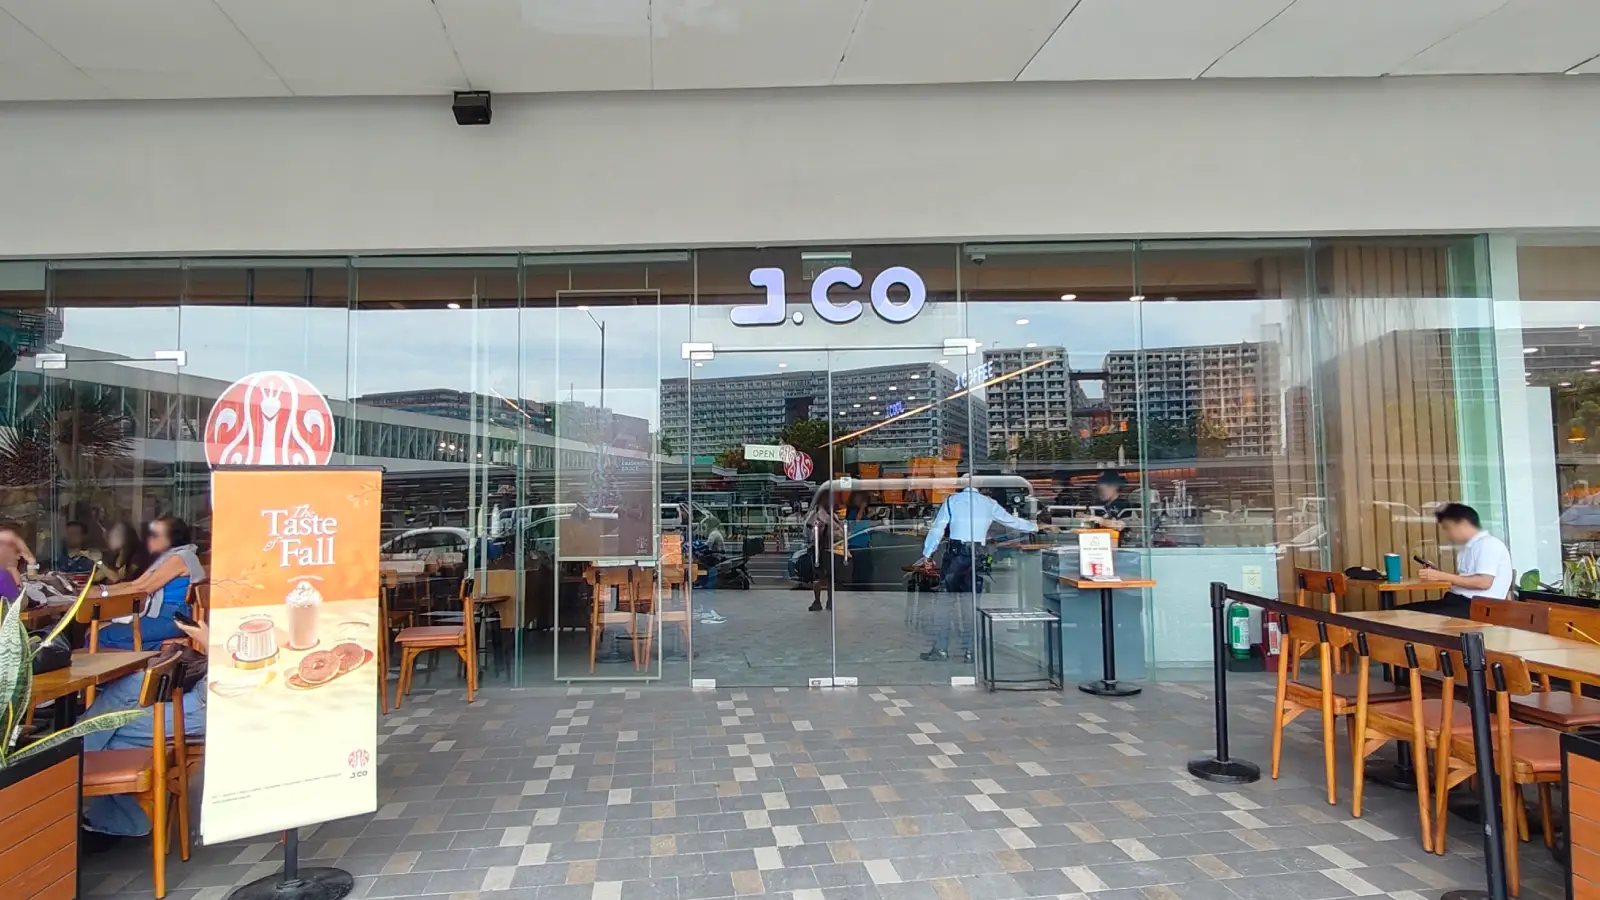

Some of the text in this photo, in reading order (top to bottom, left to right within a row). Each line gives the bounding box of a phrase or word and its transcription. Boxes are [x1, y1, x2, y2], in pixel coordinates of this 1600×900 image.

[730, 266, 926, 326] J.CO
[752, 449, 775, 458] OPEN
[260, 508, 338, 536] Taste
[293, 503, 316, 518] The
[279, 537, 336, 568] Fall
